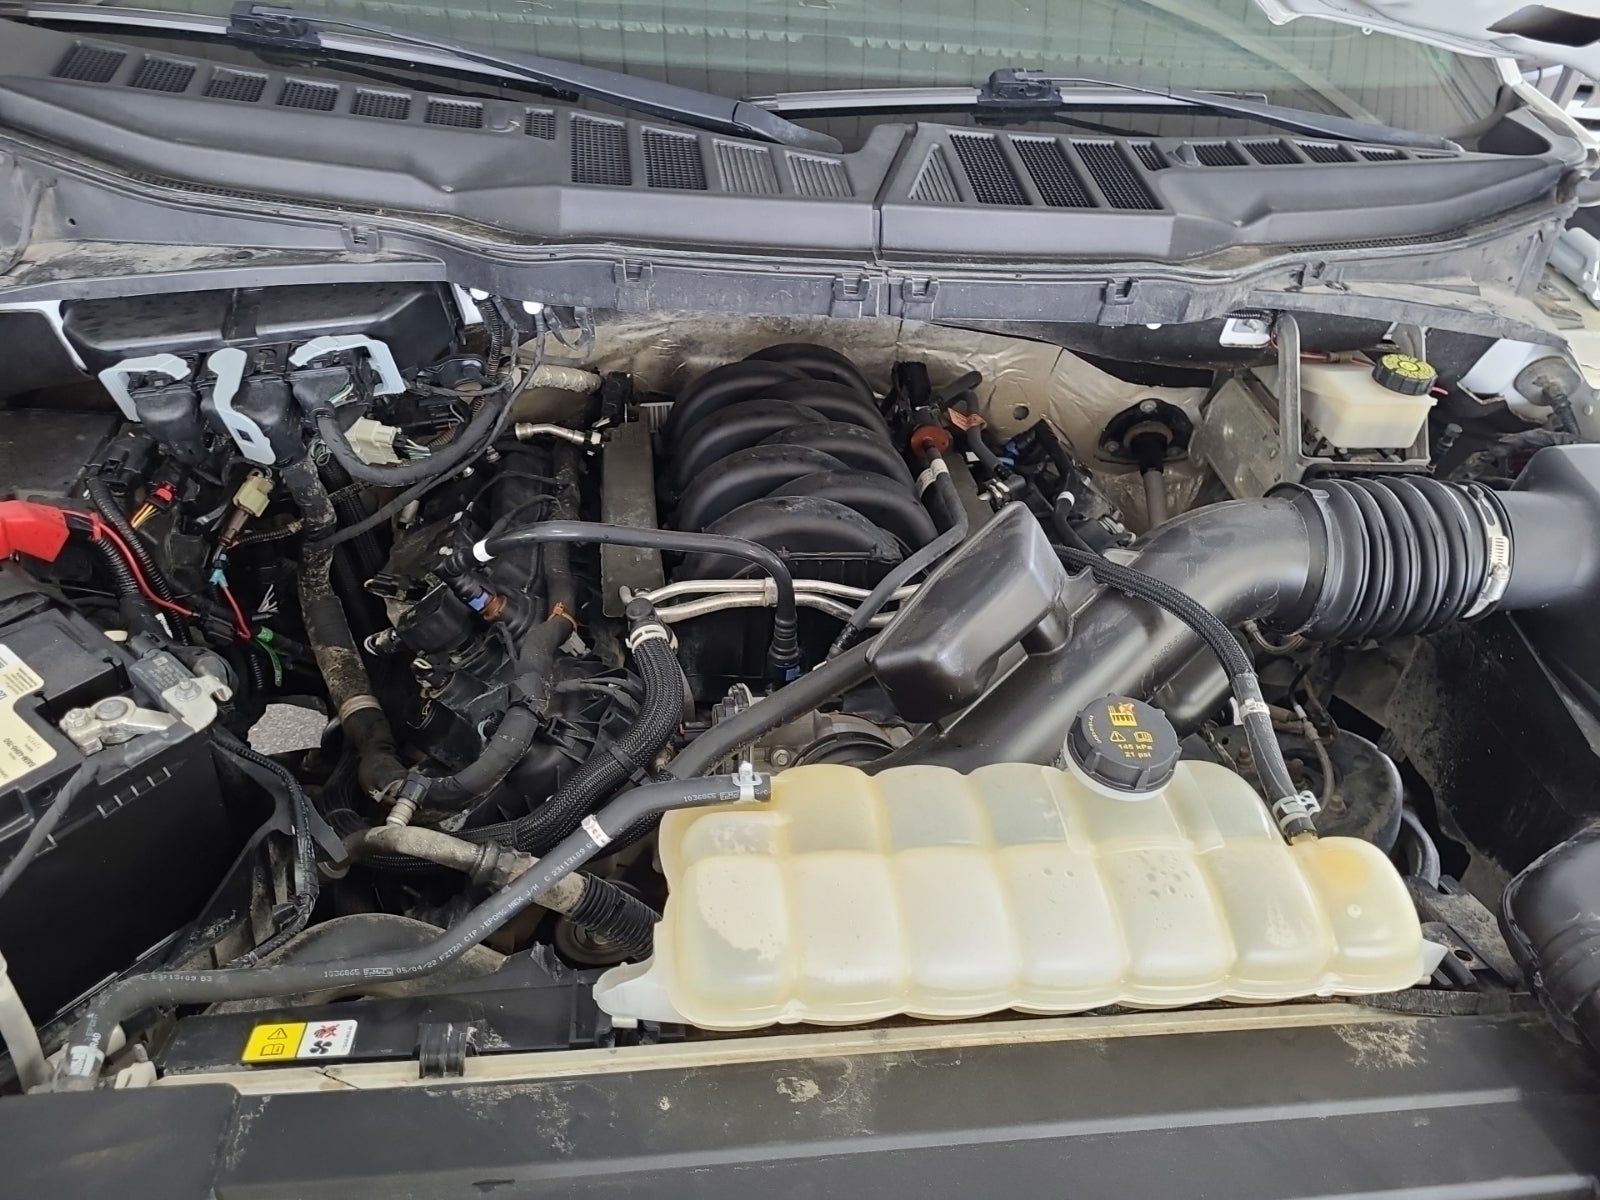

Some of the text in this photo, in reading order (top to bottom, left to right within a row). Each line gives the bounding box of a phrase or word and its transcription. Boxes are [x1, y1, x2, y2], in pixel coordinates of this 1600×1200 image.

[1137, 751, 1152, 759] psi
[324, 968, 360, 978] 1036865
[396, 959, 438, 974] 05/04/22
[463, 929, 477, 942] CIP
